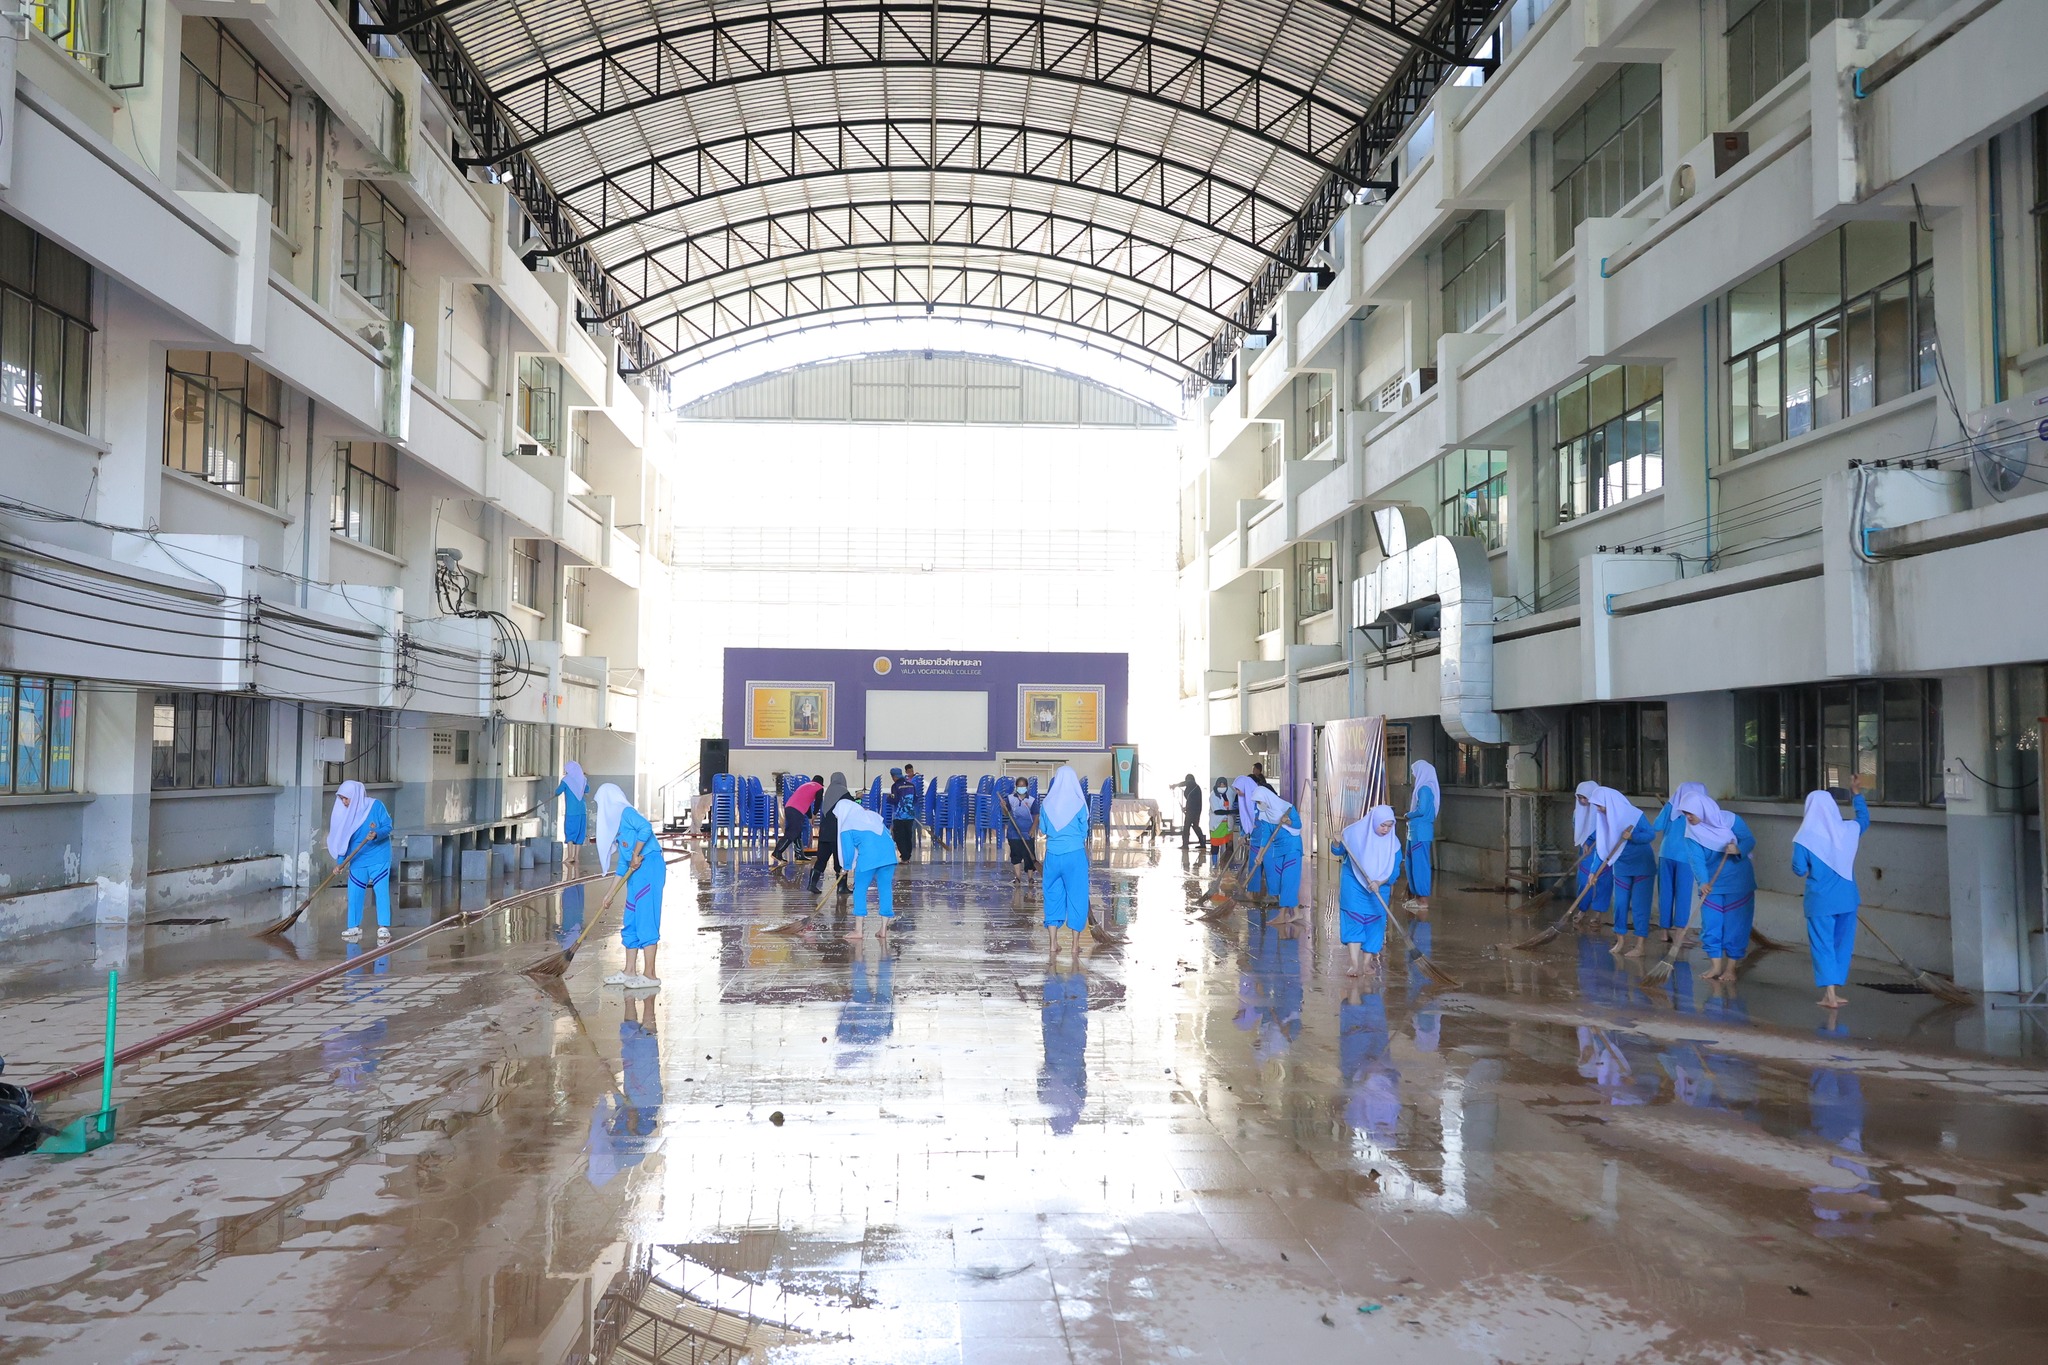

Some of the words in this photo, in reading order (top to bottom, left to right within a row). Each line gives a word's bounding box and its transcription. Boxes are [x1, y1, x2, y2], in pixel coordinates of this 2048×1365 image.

[900, 657, 982, 666] วิทยาลัยอาชีวศึกษายะลา
[1346, 726, 1366, 750] YVC
